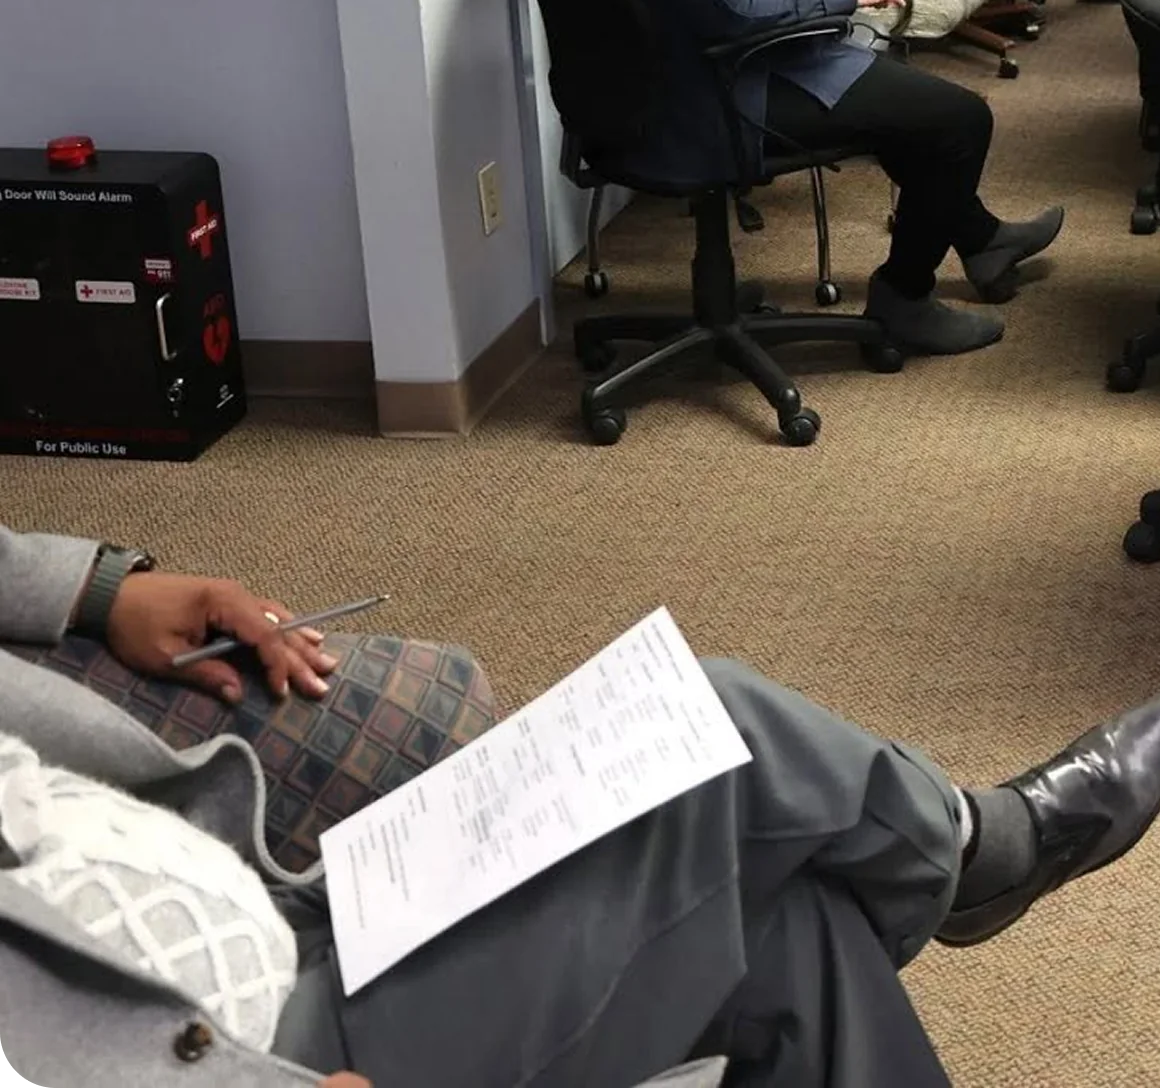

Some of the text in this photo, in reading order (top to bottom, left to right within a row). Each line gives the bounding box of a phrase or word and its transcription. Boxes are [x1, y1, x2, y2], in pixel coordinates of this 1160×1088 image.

[4, 189, 32, 200] Door
[34, 190, 57, 201] Will
[59, 191, 96, 202] Sound
[98, 192, 133, 203] Alarm
[35, 440, 127, 455] For Public Use
